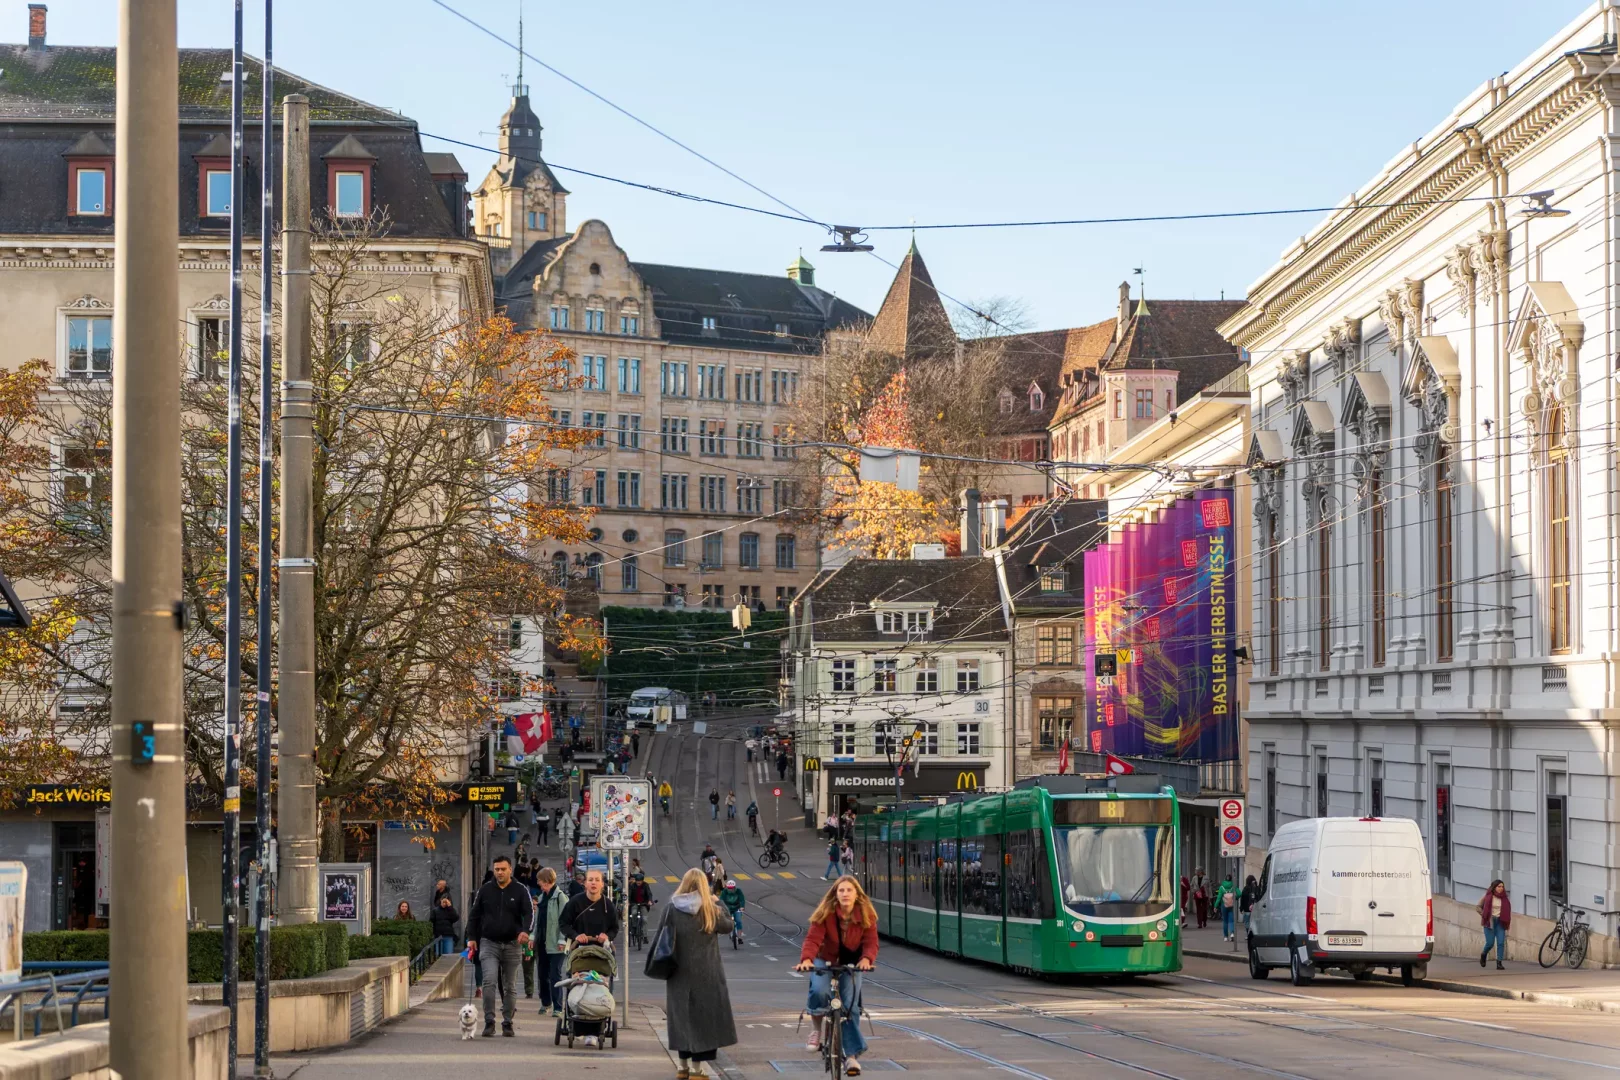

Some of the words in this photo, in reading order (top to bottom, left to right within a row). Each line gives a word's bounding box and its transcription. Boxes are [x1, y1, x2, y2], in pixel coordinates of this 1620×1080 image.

[1204, 505, 1226, 514] HERBST
[1205, 511, 1227, 521] MESSE
[1210, 535, 1226, 649] HERBSTMESSE
[1212, 653, 1227, 715] BASLER
[976, 701, 989, 712] 30
[142, 735, 155, 758] 3
[834, 777, 905, 786] McDonalds
[27, 788, 63, 802] Jack
[65, 788, 113, 802] Wolfs
[1108, 801, 1116, 818] 8
[1331, 869, 1412, 879] kammerorchesterbasel
